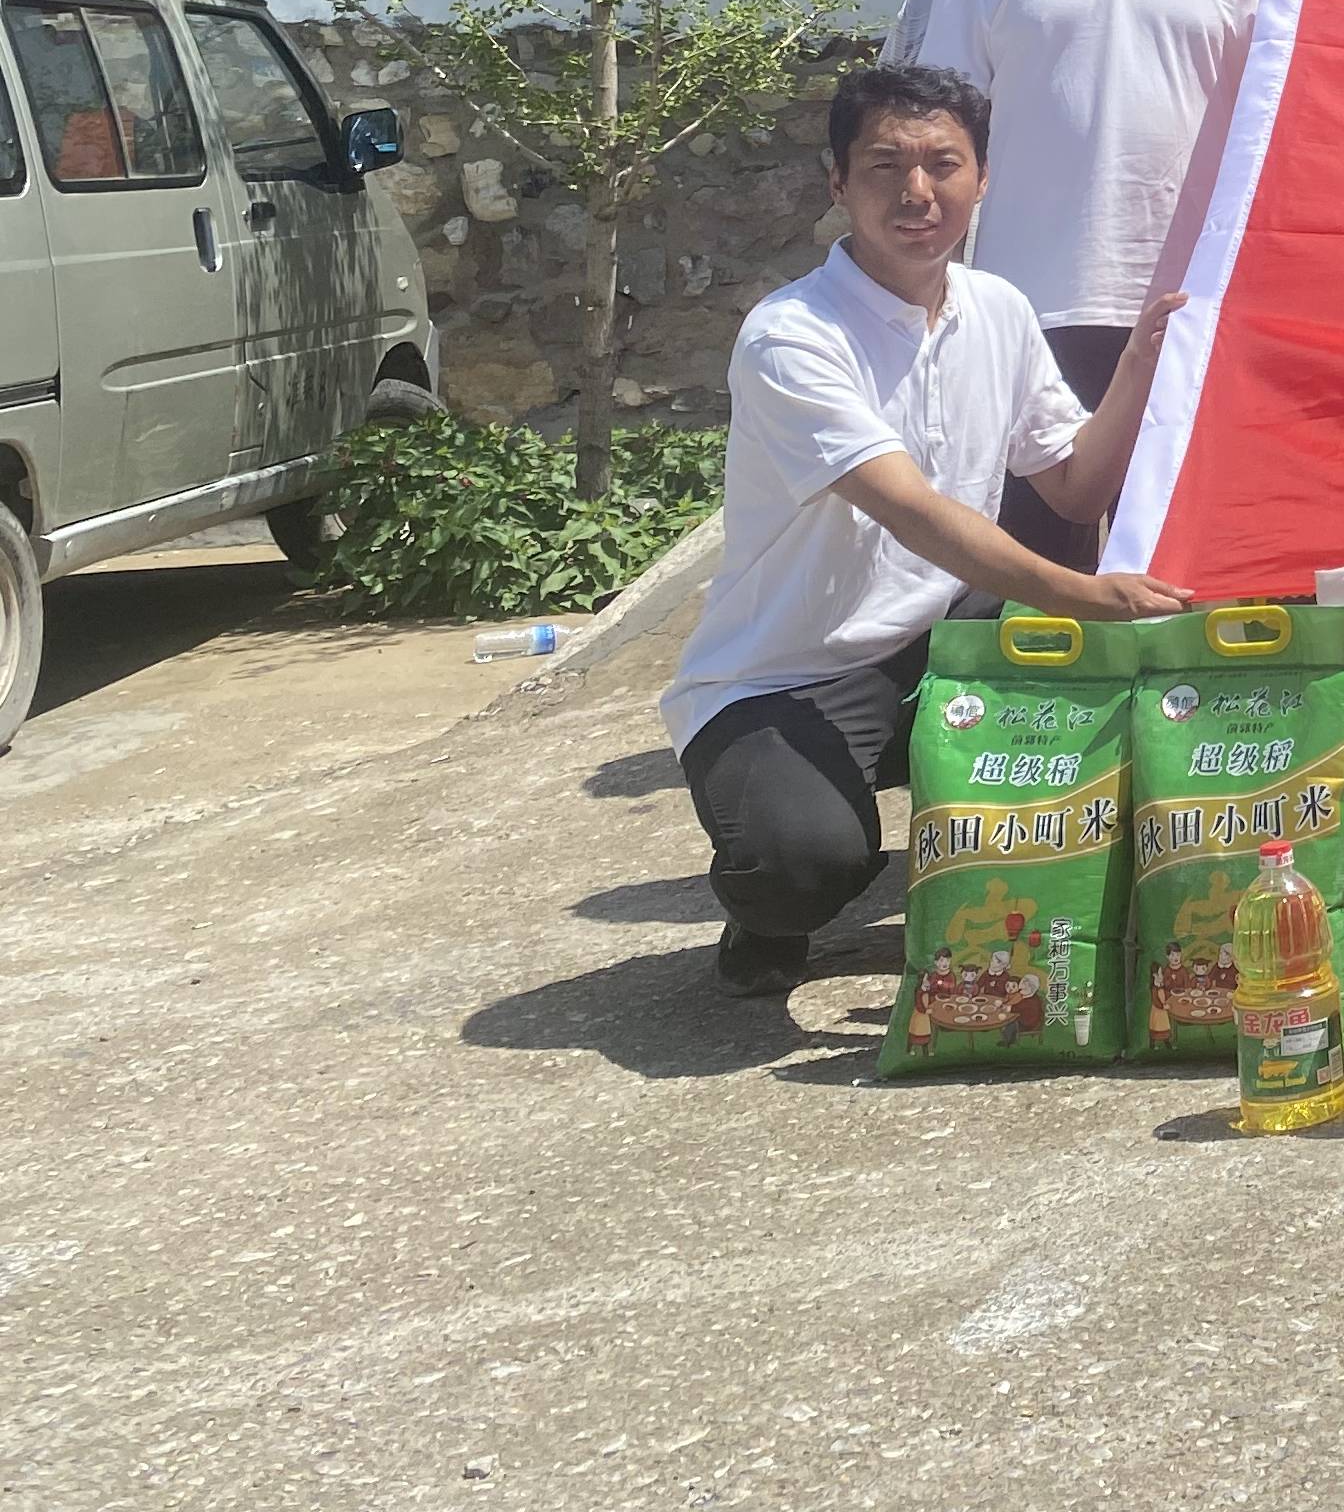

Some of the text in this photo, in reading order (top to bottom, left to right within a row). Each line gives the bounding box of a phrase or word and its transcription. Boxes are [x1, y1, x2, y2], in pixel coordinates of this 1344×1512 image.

[997, 698, 1096, 732] 松花江
[1207, 685, 1305, 718] 松花江
[968, 750, 1084, 788] 超级稻
[1187, 737, 1296, 778] 超级稻
[913, 796, 1121, 876] 秋田小町米
[1136, 780, 1337, 870] 秋田小町米
[1046, 916, 1073, 1029] 家和万事兴
[1241, 1006, 1311, 1035] 金龙鱼
